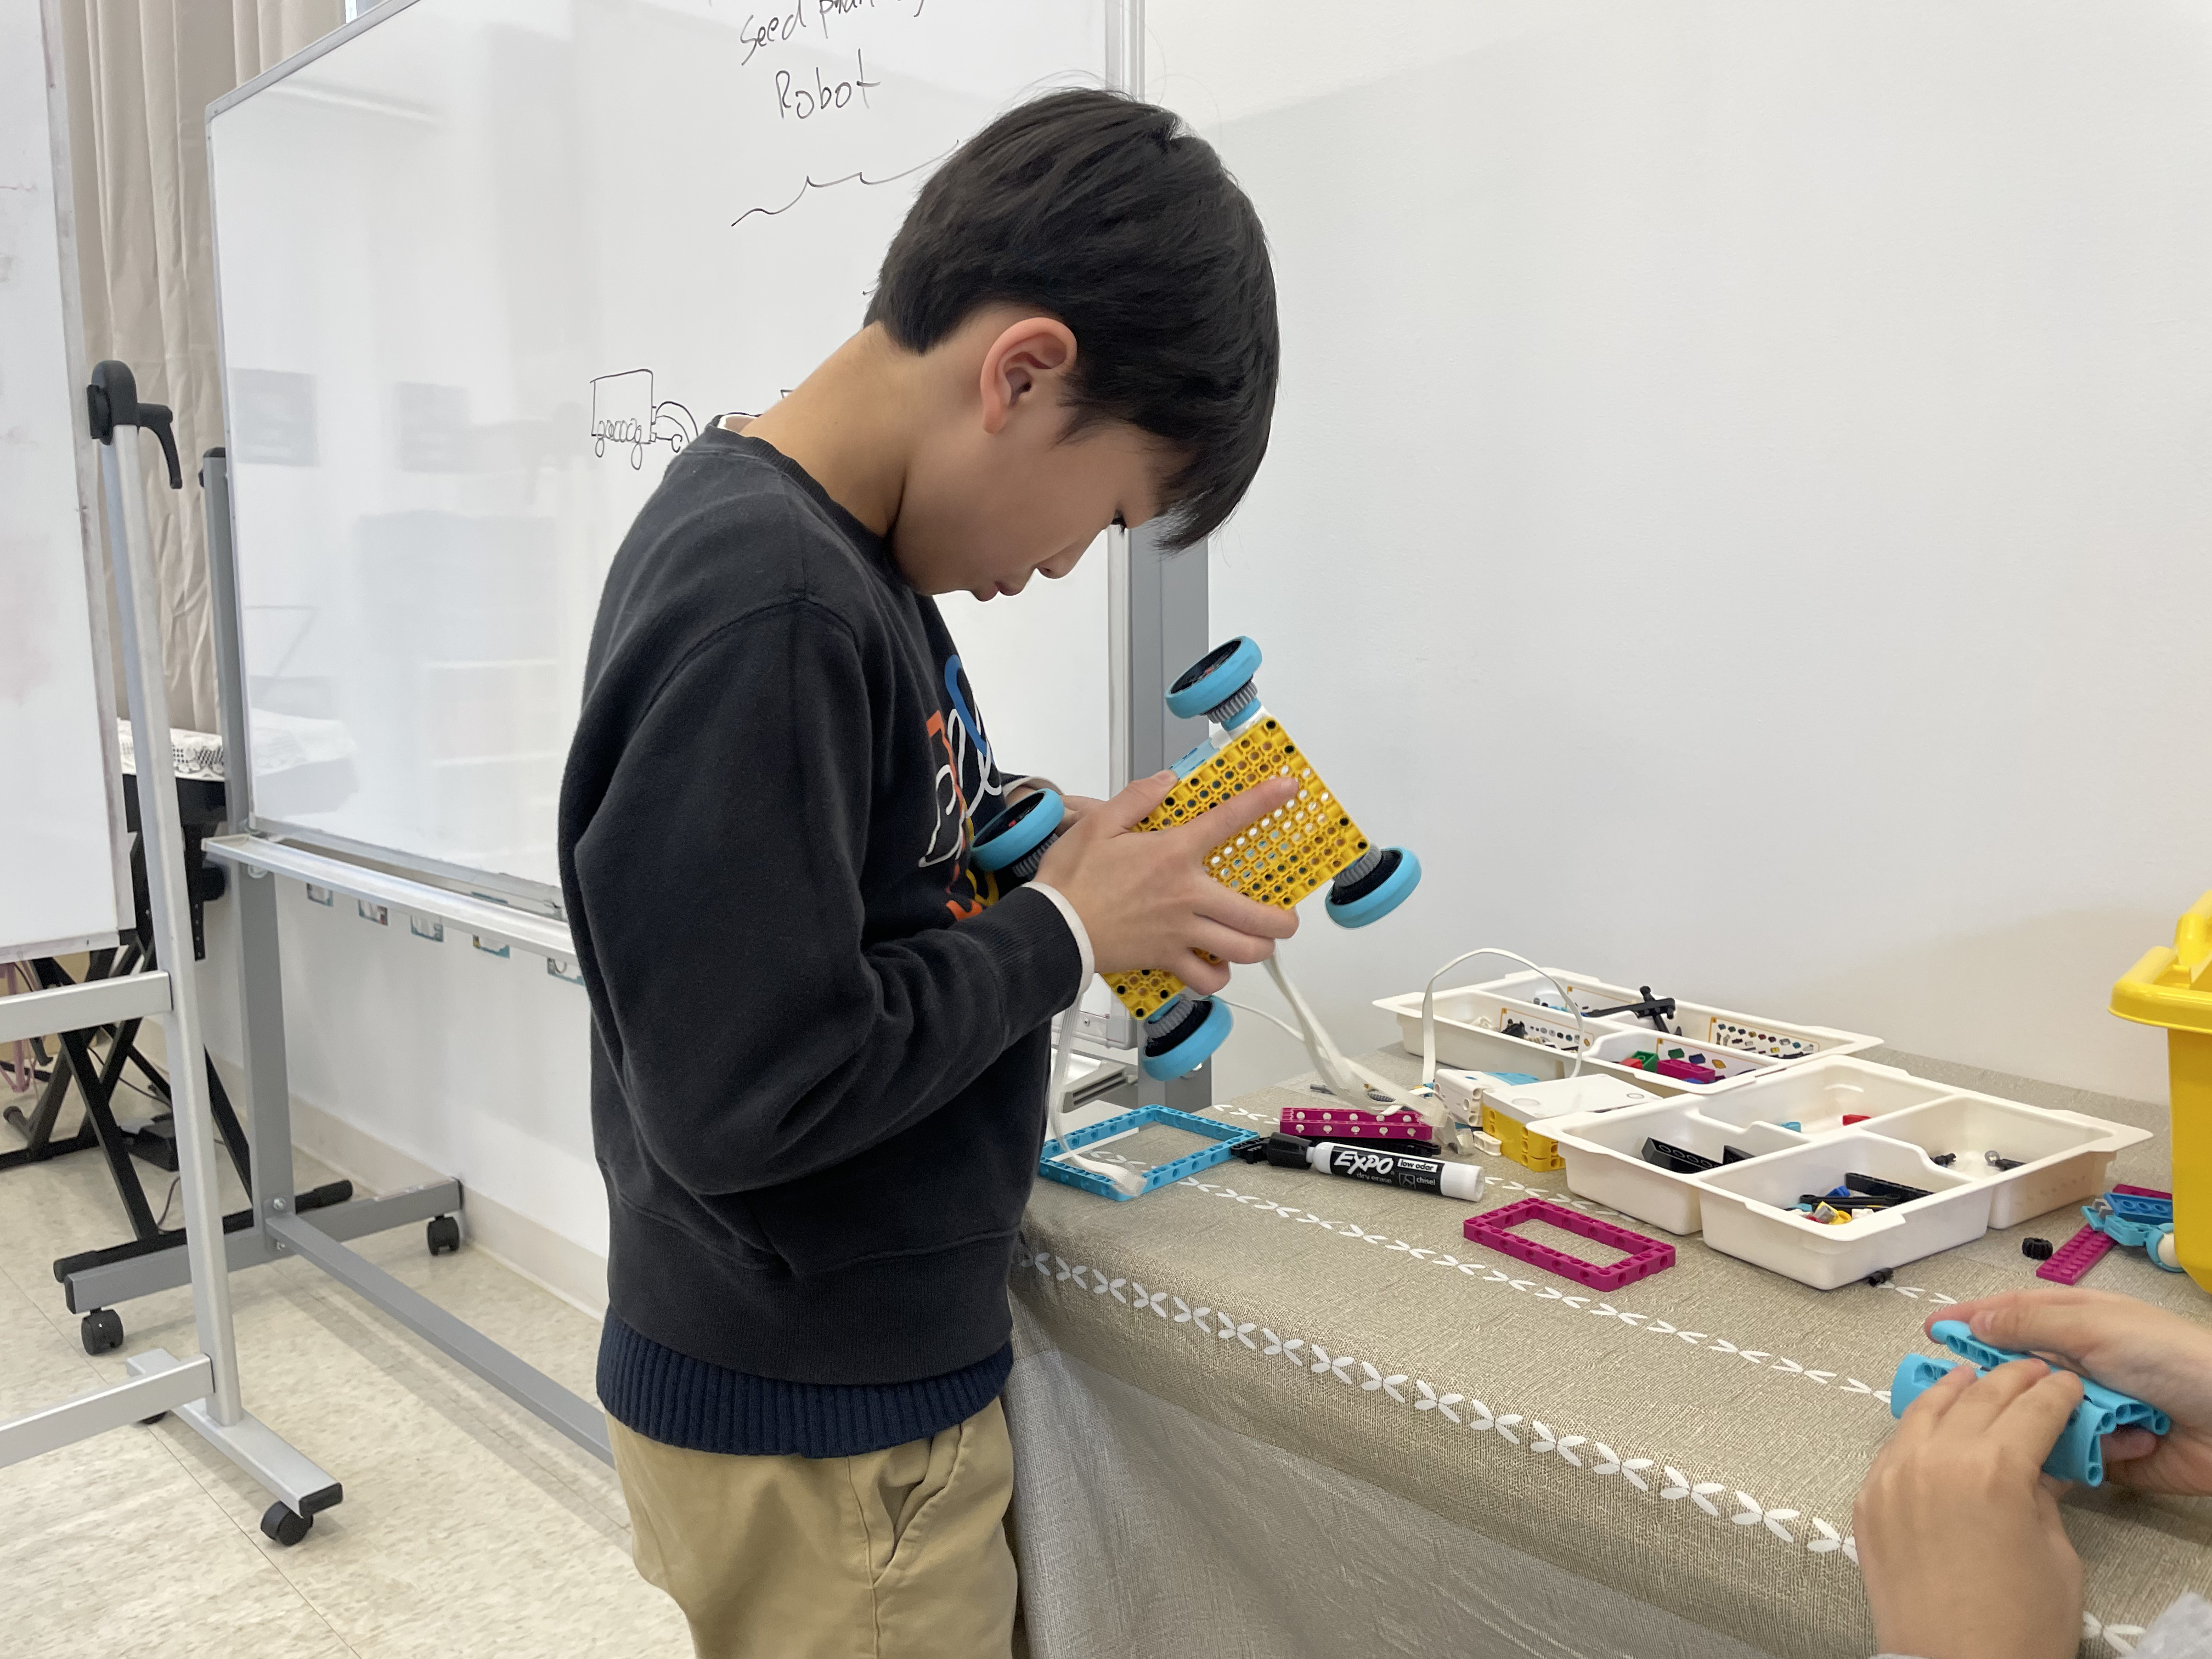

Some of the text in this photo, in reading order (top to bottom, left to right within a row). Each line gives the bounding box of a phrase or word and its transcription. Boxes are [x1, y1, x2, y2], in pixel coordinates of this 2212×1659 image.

[775, 48, 881, 119] Robot
[1334, 1151, 1394, 1175] EXPO
[1400, 1158, 1434, 1171] low odor
[1356, 1172, 1370, 1181] dry
[1416, 1176, 1436, 1186] chisel
